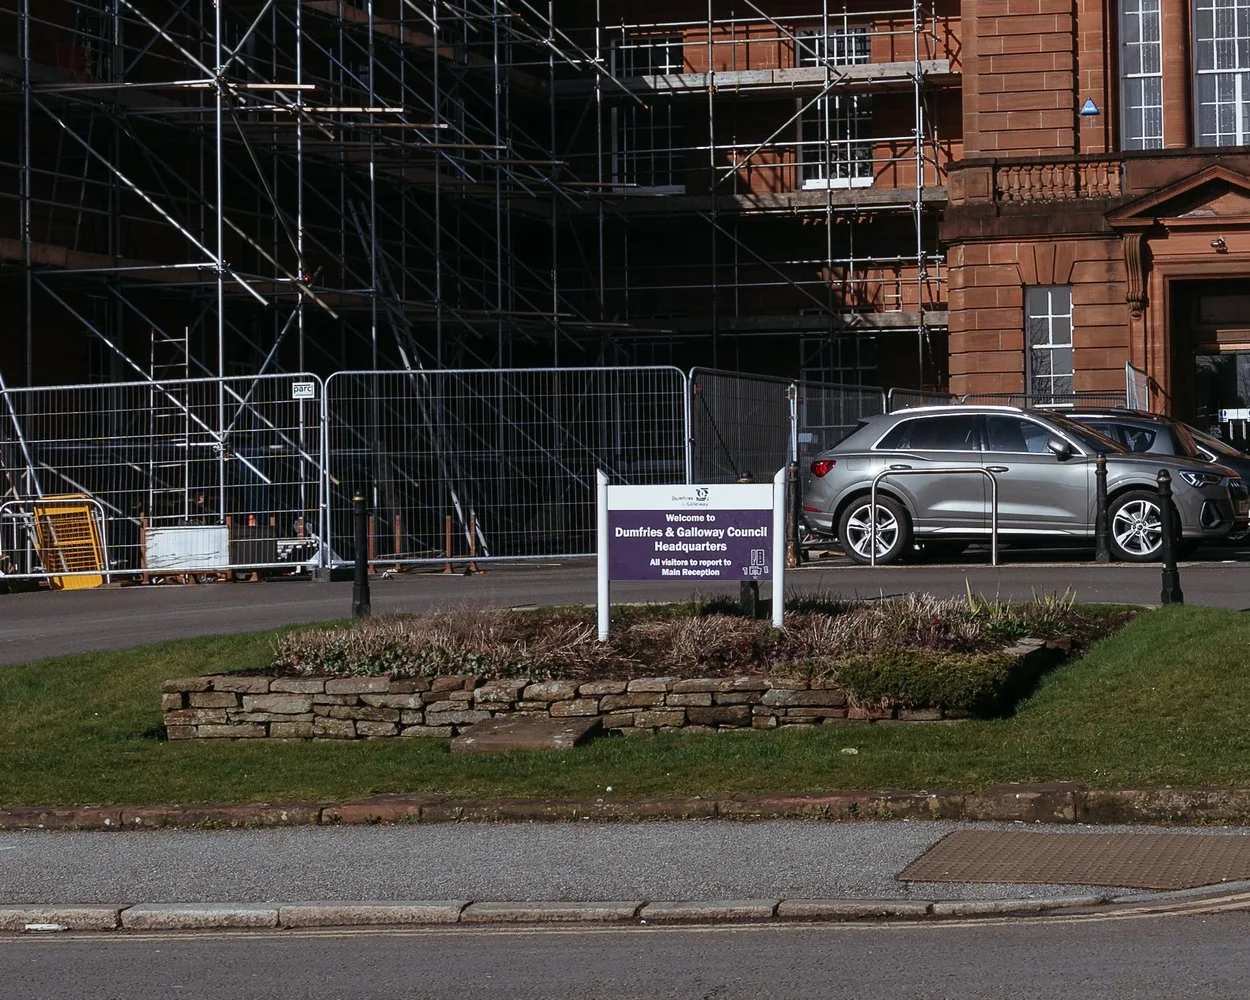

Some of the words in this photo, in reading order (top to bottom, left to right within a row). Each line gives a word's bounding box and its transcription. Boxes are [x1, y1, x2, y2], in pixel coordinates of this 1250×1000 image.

[294, 386, 311, 394] parc
[665, 513, 704, 522] Welcome
[706, 514, 716, 522] to
[615, 526, 663, 537] Dumfries
[666, 526, 675, 537] &
[676, 526, 725, 539] Galloway
[726, 526, 768, 537] Council
[654, 541, 728, 553] Headquarters
[649, 558, 660, 566] All
[661, 558, 689, 566] visitors
[689, 558, 697, 566] to
[698, 558, 723, 567] report
[723, 558, 732, 566] to
[661, 568, 681, 576] Main
[682, 568, 720, 577] Reception
